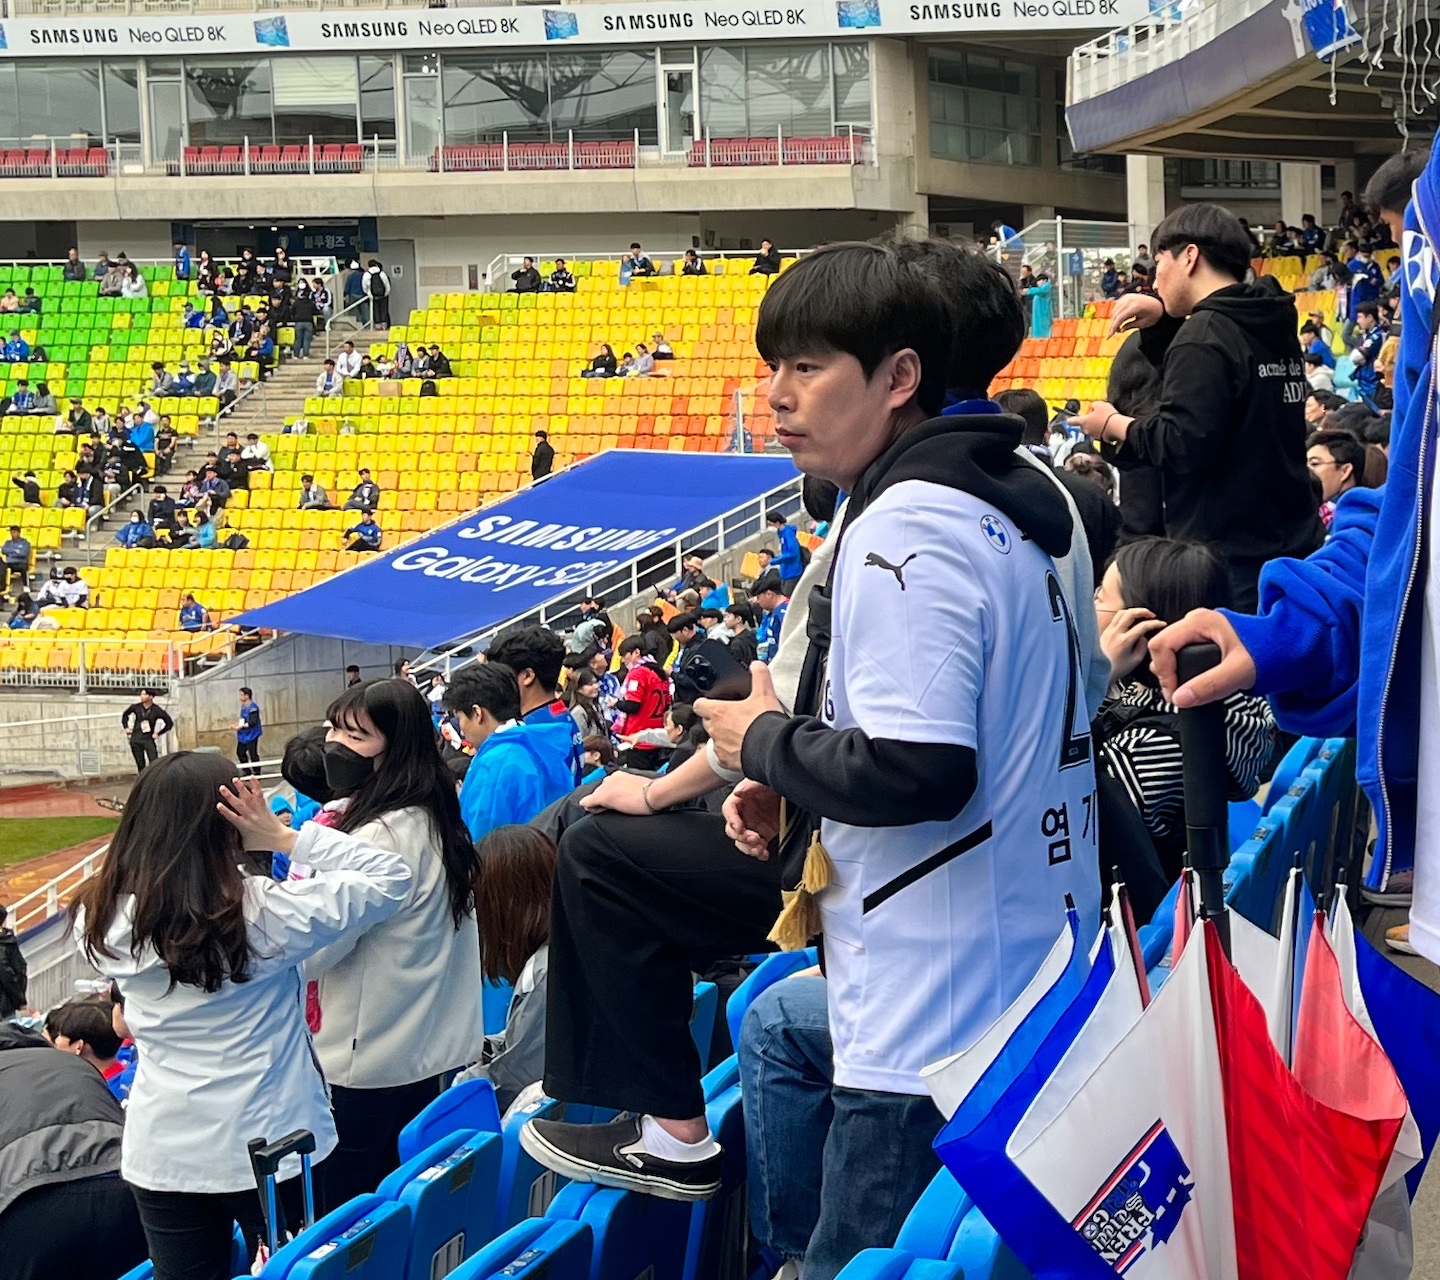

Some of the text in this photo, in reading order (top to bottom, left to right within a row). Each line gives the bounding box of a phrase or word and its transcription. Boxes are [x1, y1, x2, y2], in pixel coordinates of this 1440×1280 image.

[603, 9, 806, 31] SAMSUNG Neo QLED 8K
[910, 2, 1001, 20] SAMSUNG
[1013, 1, 1049, 18] Neo
[1052, 0, 1096, 17] QLED
[30, 26, 226, 44] SAMSUNG Neo QLED 8K
[321, 18, 520, 38] SAMSUNG Neo QLED 8K
[457, 515, 676, 552] SAMSUNG
[391, 547, 618, 592] Galaxy S23
